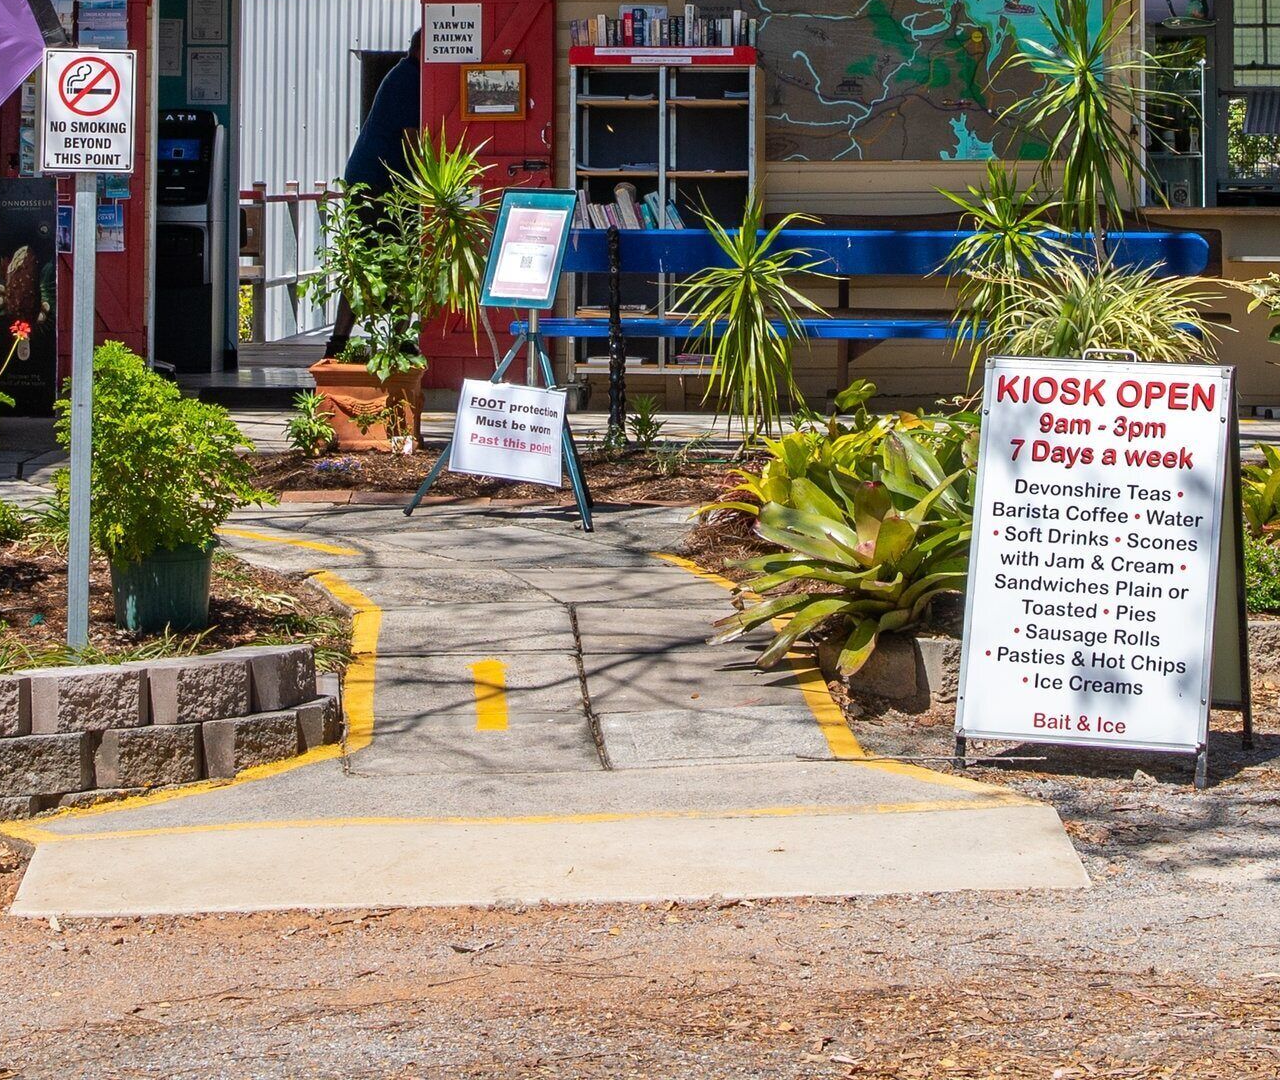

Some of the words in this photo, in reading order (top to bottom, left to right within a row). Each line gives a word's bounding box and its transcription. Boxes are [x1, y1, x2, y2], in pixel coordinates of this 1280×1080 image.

[432, 21, 475, 30] YARWUN
[432, 33, 474, 42] RAILWAY
[432, 46, 474, 55] STATION
[50, 121, 67, 133] NO
[70, 121, 127, 134] SMOKING
[64, 137, 112, 149] BEYOND
[54, 152, 81, 165] THIS
[85, 153, 122, 166] POINT
[996, 375, 1106, 407] KIOSK
[1117, 381, 1217, 412] OPEN
[470, 396, 506, 410] FOOT
[509, 403, 558, 419] protection
[475, 415, 507, 429] Must
[511, 420, 526, 431] be
[530, 424, 551, 436] worn
[1039, 412, 1091, 436] 9am
[1113, 416, 1166, 440] 3pm
[470, 432, 499, 446] Past
[503, 437, 526, 450] this
[530, 442, 552, 453] point
[1010, 438, 1024, 462] 7
[1032, 440, 1095, 469] Days
[1101, 449, 1117, 467] a
[1123, 445, 1194, 470] week
[1014, 478, 1121, 501] Devonshire
[1126, 483, 1172, 503] Teas
[992, 501, 1061, 523] Barista
[1065, 505, 1129, 526] Coffee
[1145, 509, 1204, 530] Water
[1004, 525, 1043, 545] Soft
[1048, 528, 1109, 548] Drinks
[1126, 532, 1198, 552] Scones
[1000, 550, 1039, 568] with
[1044, 552, 1086, 571] Jam
[1090, 553, 1106, 572] &
[1110, 556, 1175, 576] Cream
[994, 573, 1109, 597] Sandwiches
[1115, 580, 1164, 600] Plain
[1168, 585, 1190, 601] or
[1021, 599, 1098, 620] Toasted
[1115, 604, 1157, 623] Pies
[1024, 622, 1108, 647] Sausage
[1113, 627, 1161, 648] Rolls
[996, 645, 1066, 667] Pasties
[1071, 649, 1086, 668] &
[1090, 651, 1126, 671] Hot
[1130, 653, 1187, 675] Chips
[1033, 672, 1063, 691] Ice
[1068, 675, 1144, 696] Creams
[1032, 711, 1072, 731] Bait
[1076, 715, 1091, 733] &
[1097, 716, 1127, 735] Ice
